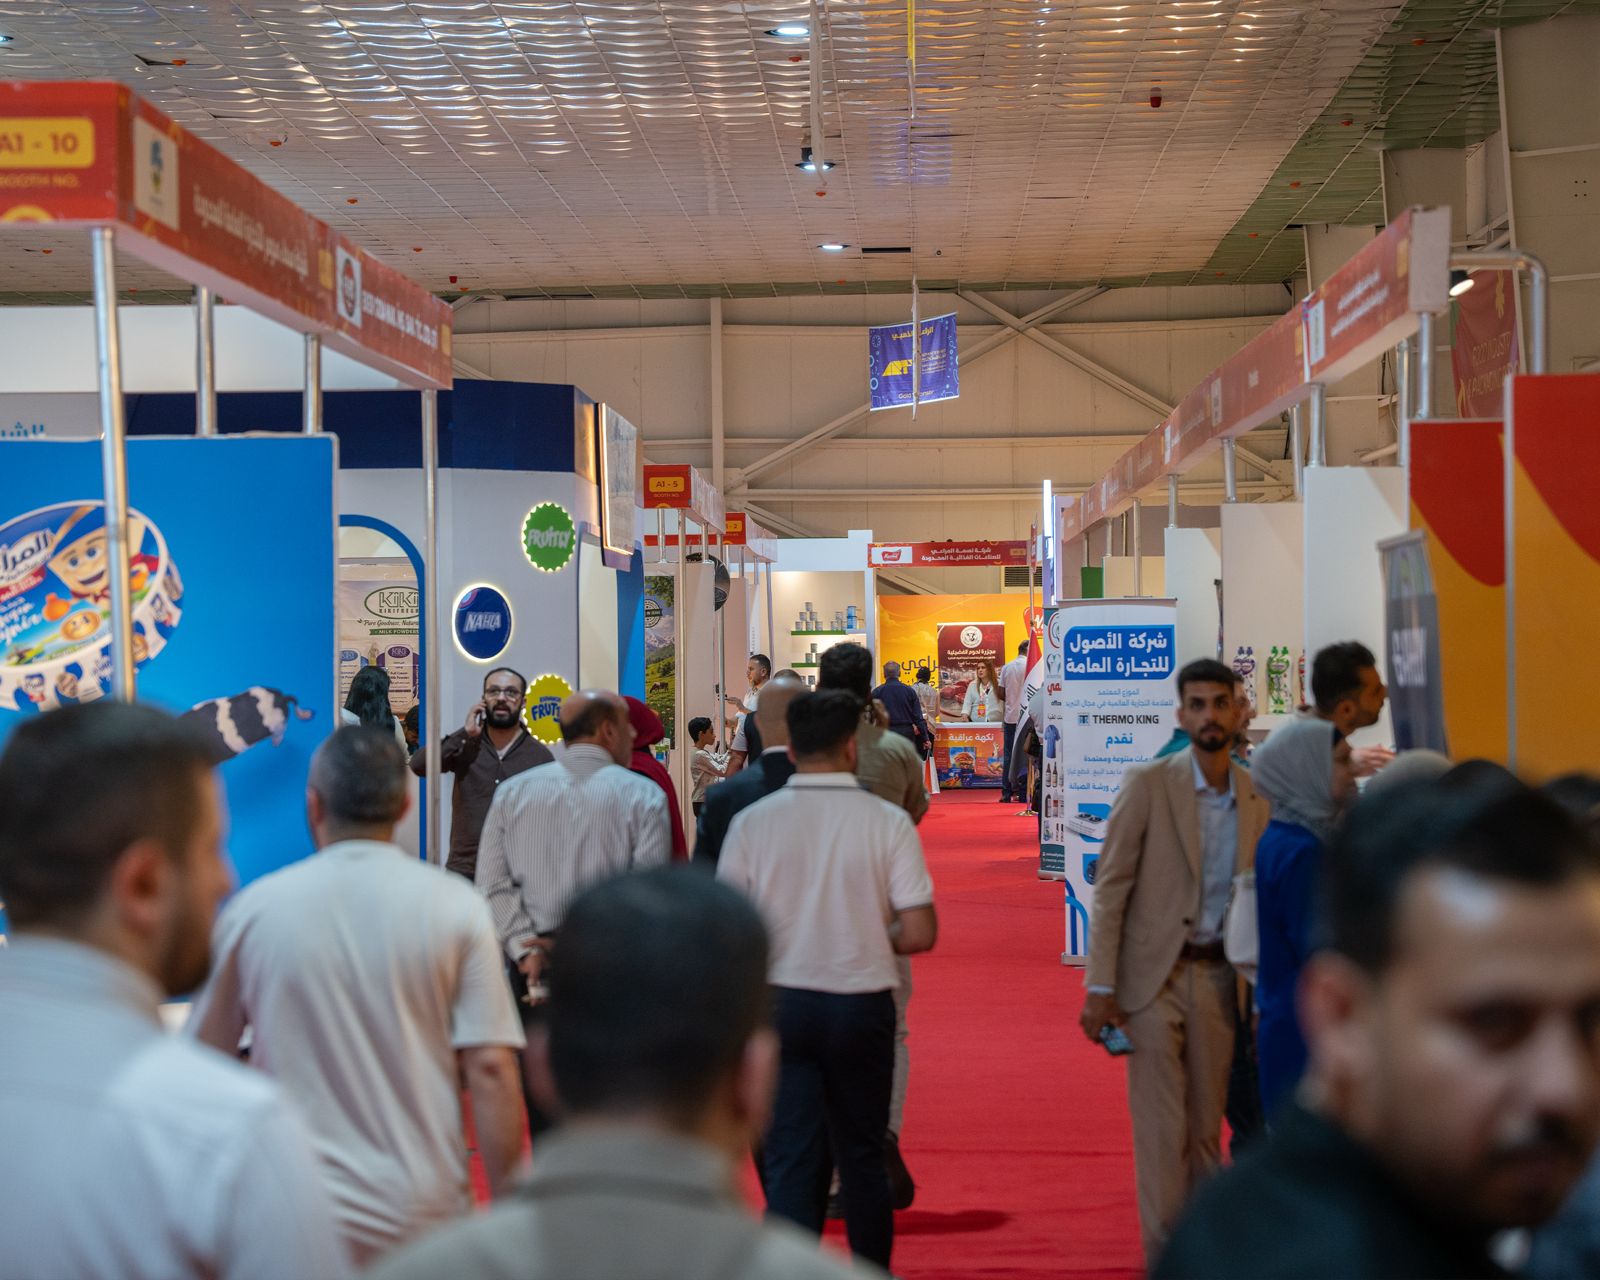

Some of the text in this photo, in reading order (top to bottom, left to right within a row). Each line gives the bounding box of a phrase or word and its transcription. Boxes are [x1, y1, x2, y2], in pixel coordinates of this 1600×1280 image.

[48, 132, 80, 154] 10
[1069, 631, 1168, 655] شركة الأصول
[1066, 656, 1169, 677] للتجارة العامة
[1092, 714, 1135, 725] THERMO
[1136, 714, 1160, 725] KING
[1105, 732, 1134, 749] نقدم
